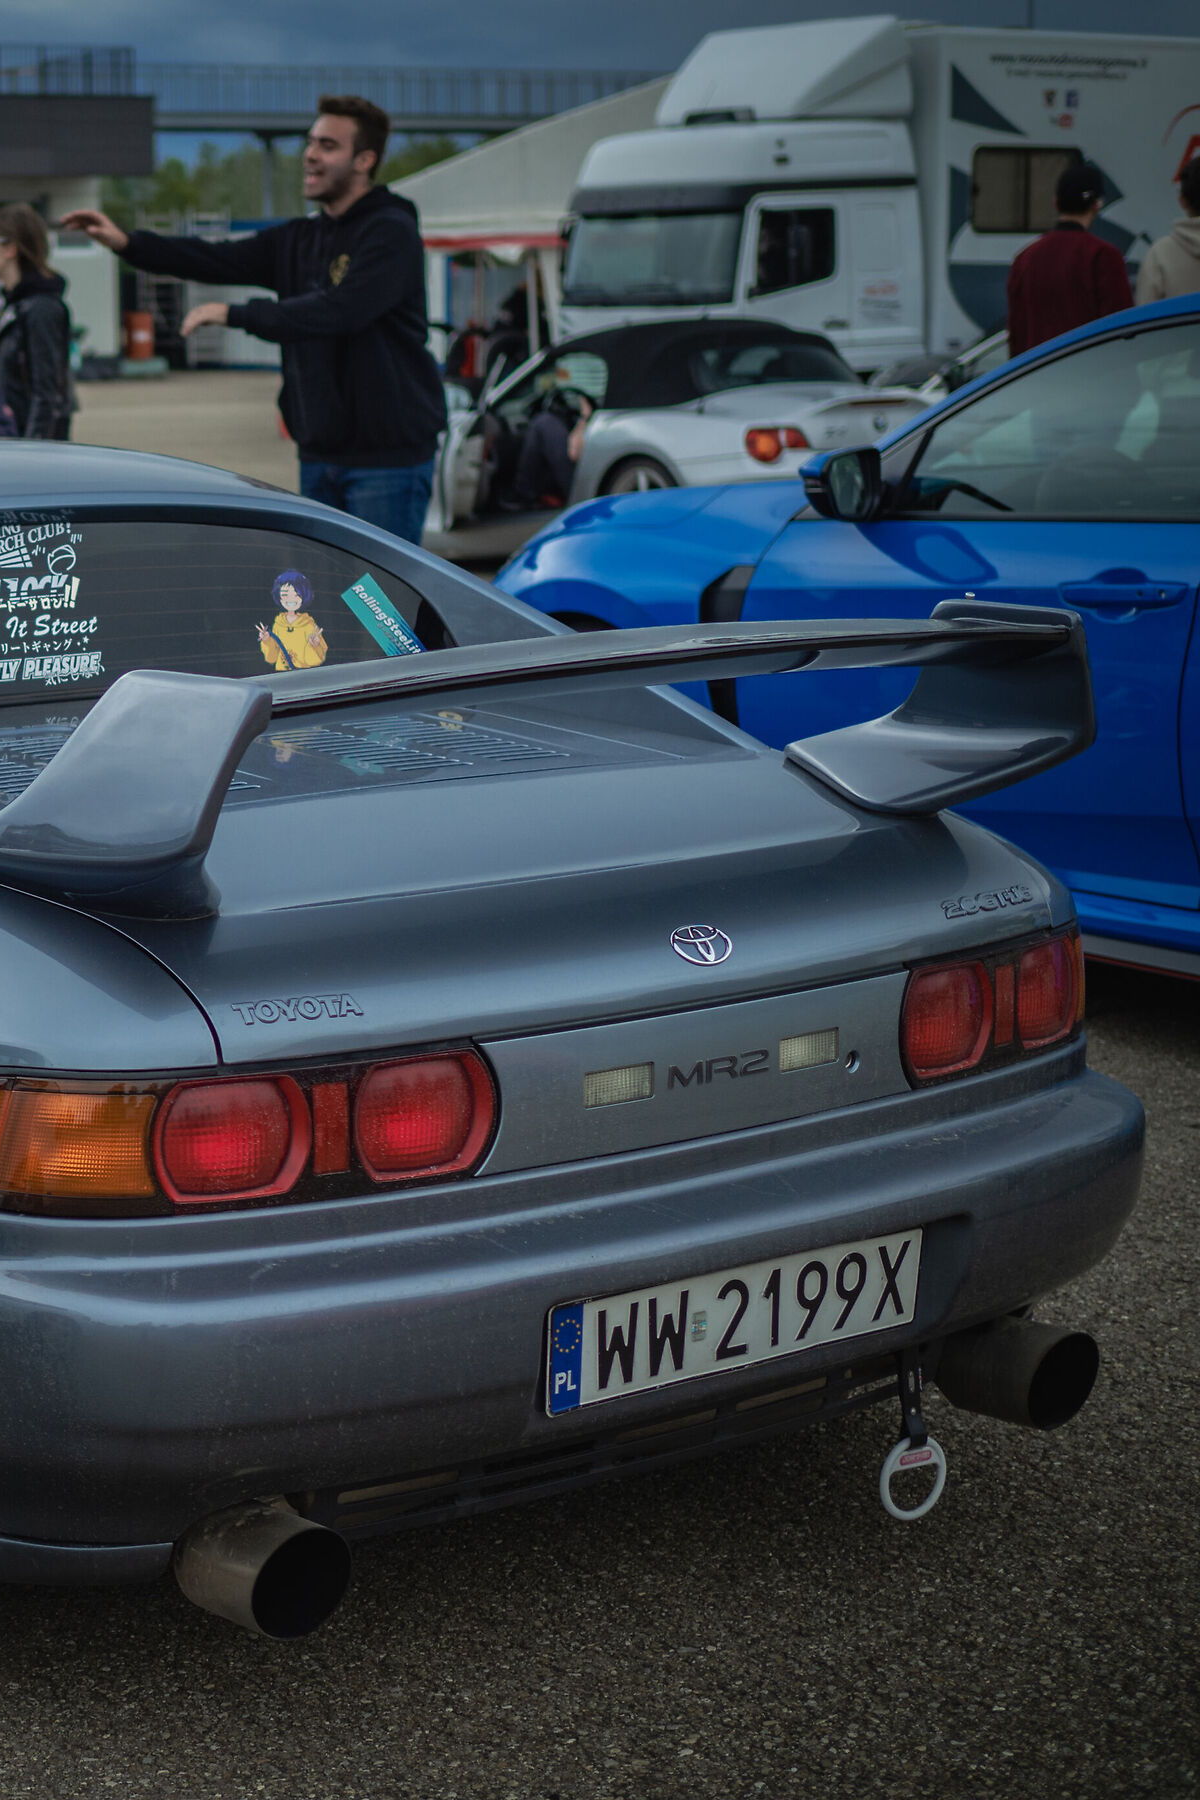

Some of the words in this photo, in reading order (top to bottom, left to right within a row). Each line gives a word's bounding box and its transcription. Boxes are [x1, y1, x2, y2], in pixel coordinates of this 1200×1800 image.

[27, 522, 72, 543] CLUB!
[6, 616, 28, 638] It
[33, 614, 98, 637] Street
[352, 584, 421, 653] RollingSteel.it
[22, 652, 101, 680] PLEASURE
[231, 993, 364, 1026] TOYOTA
[667, 1049, 770, 1090] MR2
[597, 1289, 689, 1390] WW
[714, 1239, 912, 1361] 2199X
[554, 1369, 577, 1395] PL
